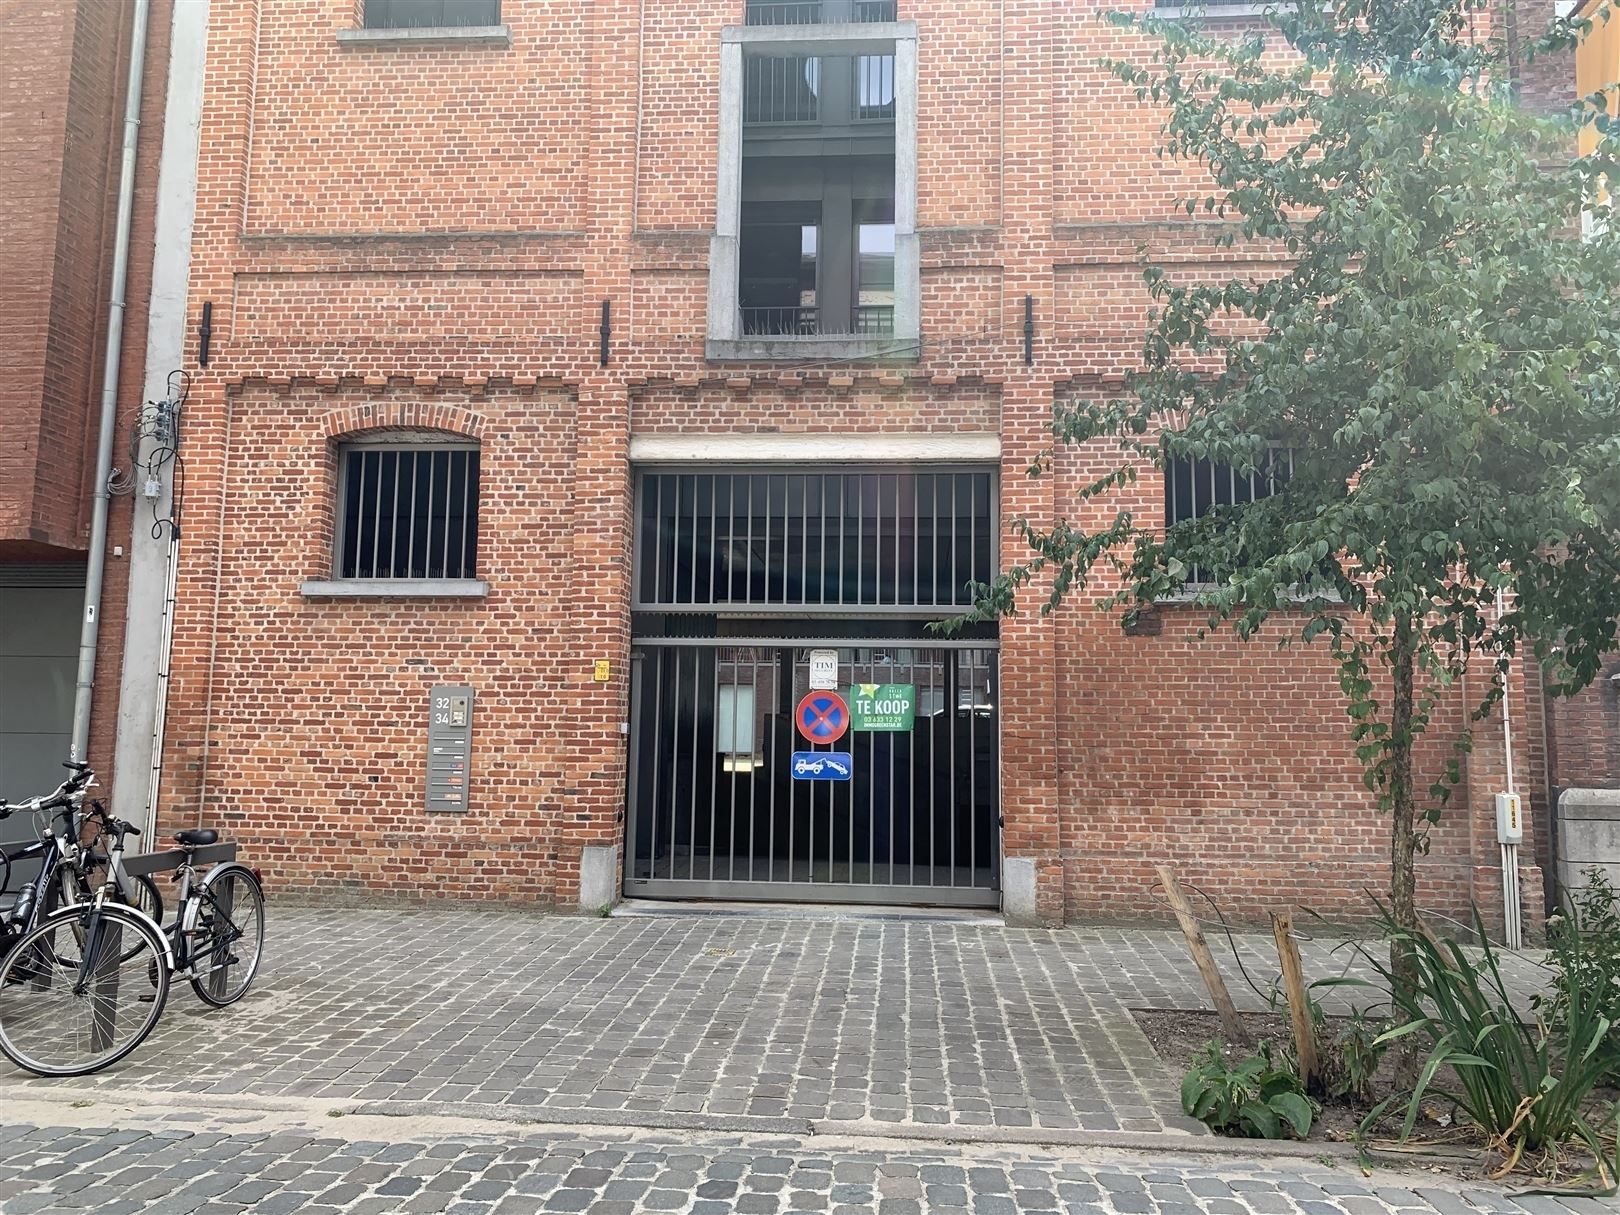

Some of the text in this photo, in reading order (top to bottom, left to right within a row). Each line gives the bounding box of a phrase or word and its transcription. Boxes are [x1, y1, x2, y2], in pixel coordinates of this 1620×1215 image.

[436, 697, 450, 709] 32
[856, 700, 910, 715] TE KOOP
[435, 712, 449, 724] 34
